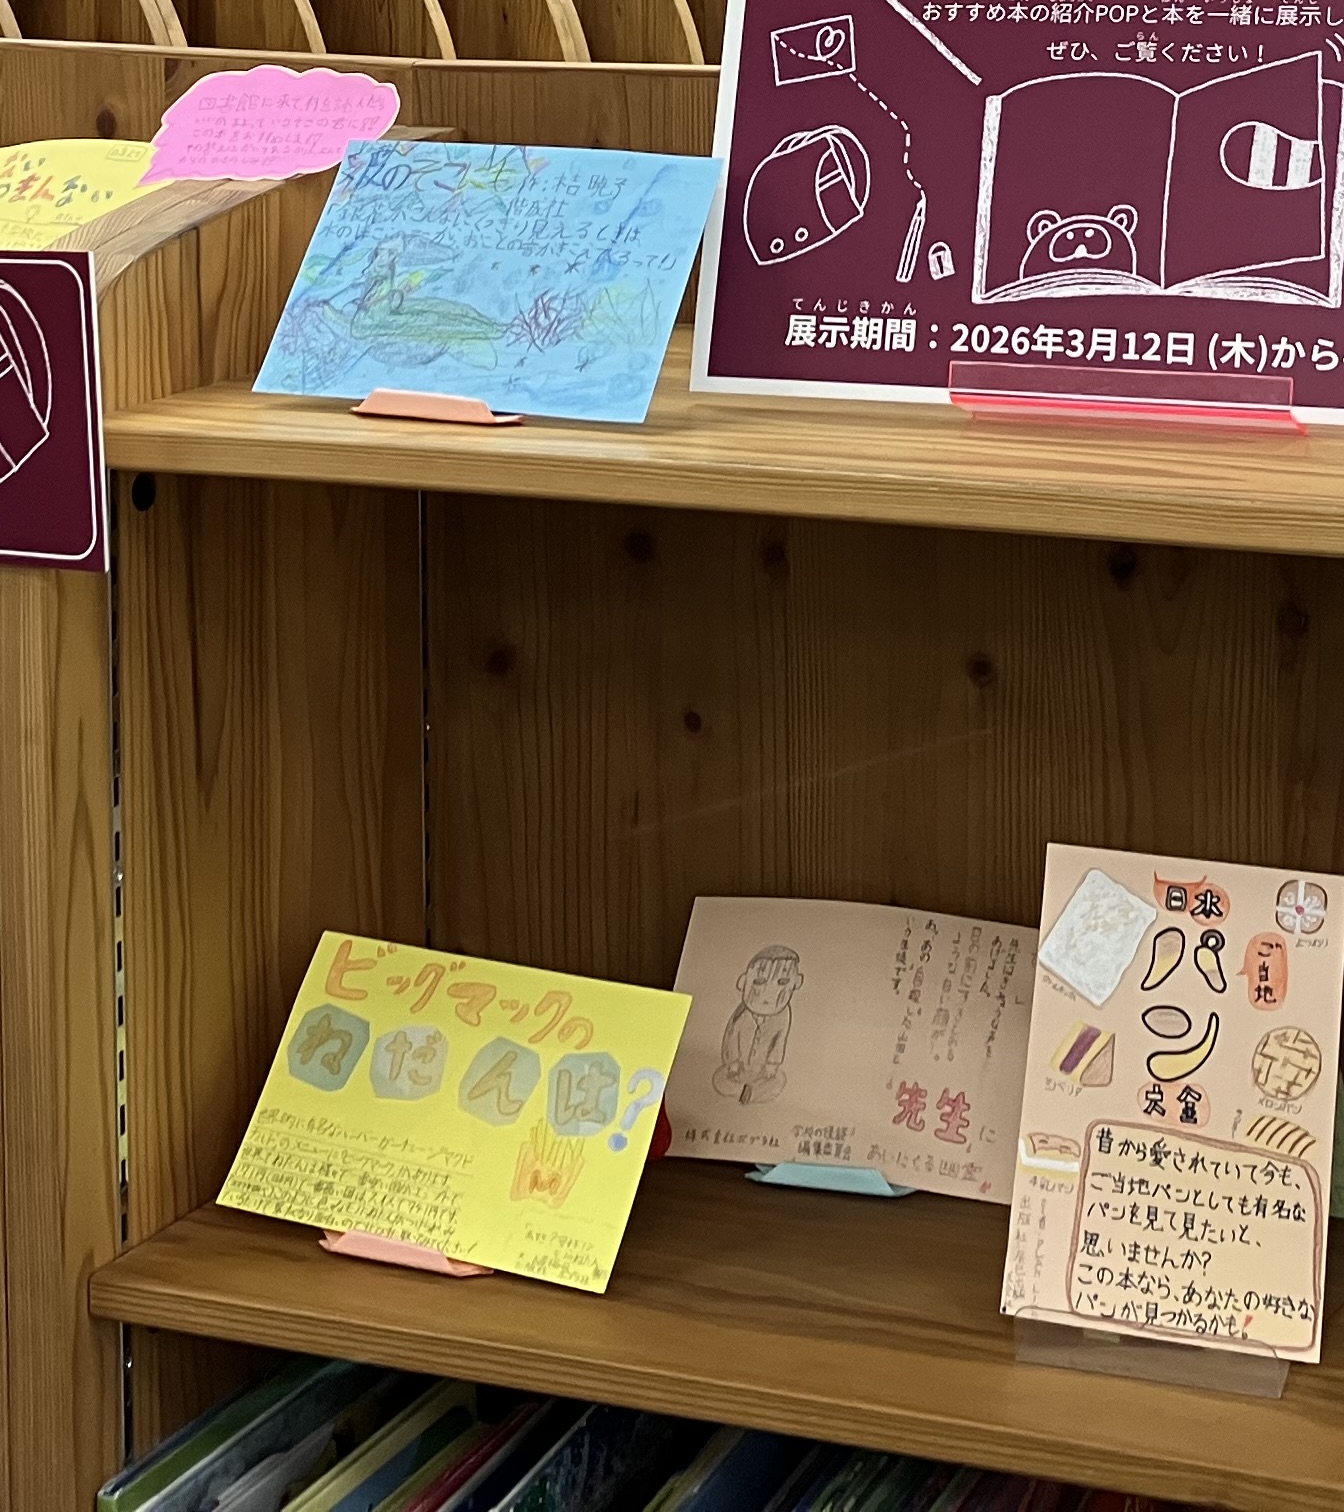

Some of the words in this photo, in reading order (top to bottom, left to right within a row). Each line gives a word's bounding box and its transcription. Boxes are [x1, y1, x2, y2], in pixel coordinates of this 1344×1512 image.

[1045, 39, 1266, 64] ぜひ、ご覧ください！
[791, 297, 918, 316] てんじきかん
[784, 313, 1196, 367] 展示期間：2026年3月12日
[324, 938, 594, 1050] ビッグマックの
[1253, 940, 1284, 1005] ご当地
[1140, 926, 1228, 1082] パン
[892, 1078, 972, 1145] 先生
[1095, 1126, 1302, 1190] 昔から愛されていて今も、
[1090, 1170, 1307, 1223] ご当地パンとしても有名な
[1086, 1201, 1262, 1248] パンを見て見たいと、
[1079, 1230, 1213, 1277] 思いませんか?
[1074, 1290, 1255, 1340] パンが見つかるかも!
[1076, 1262, 1315, 1325] この本なら、あなたの好きな
